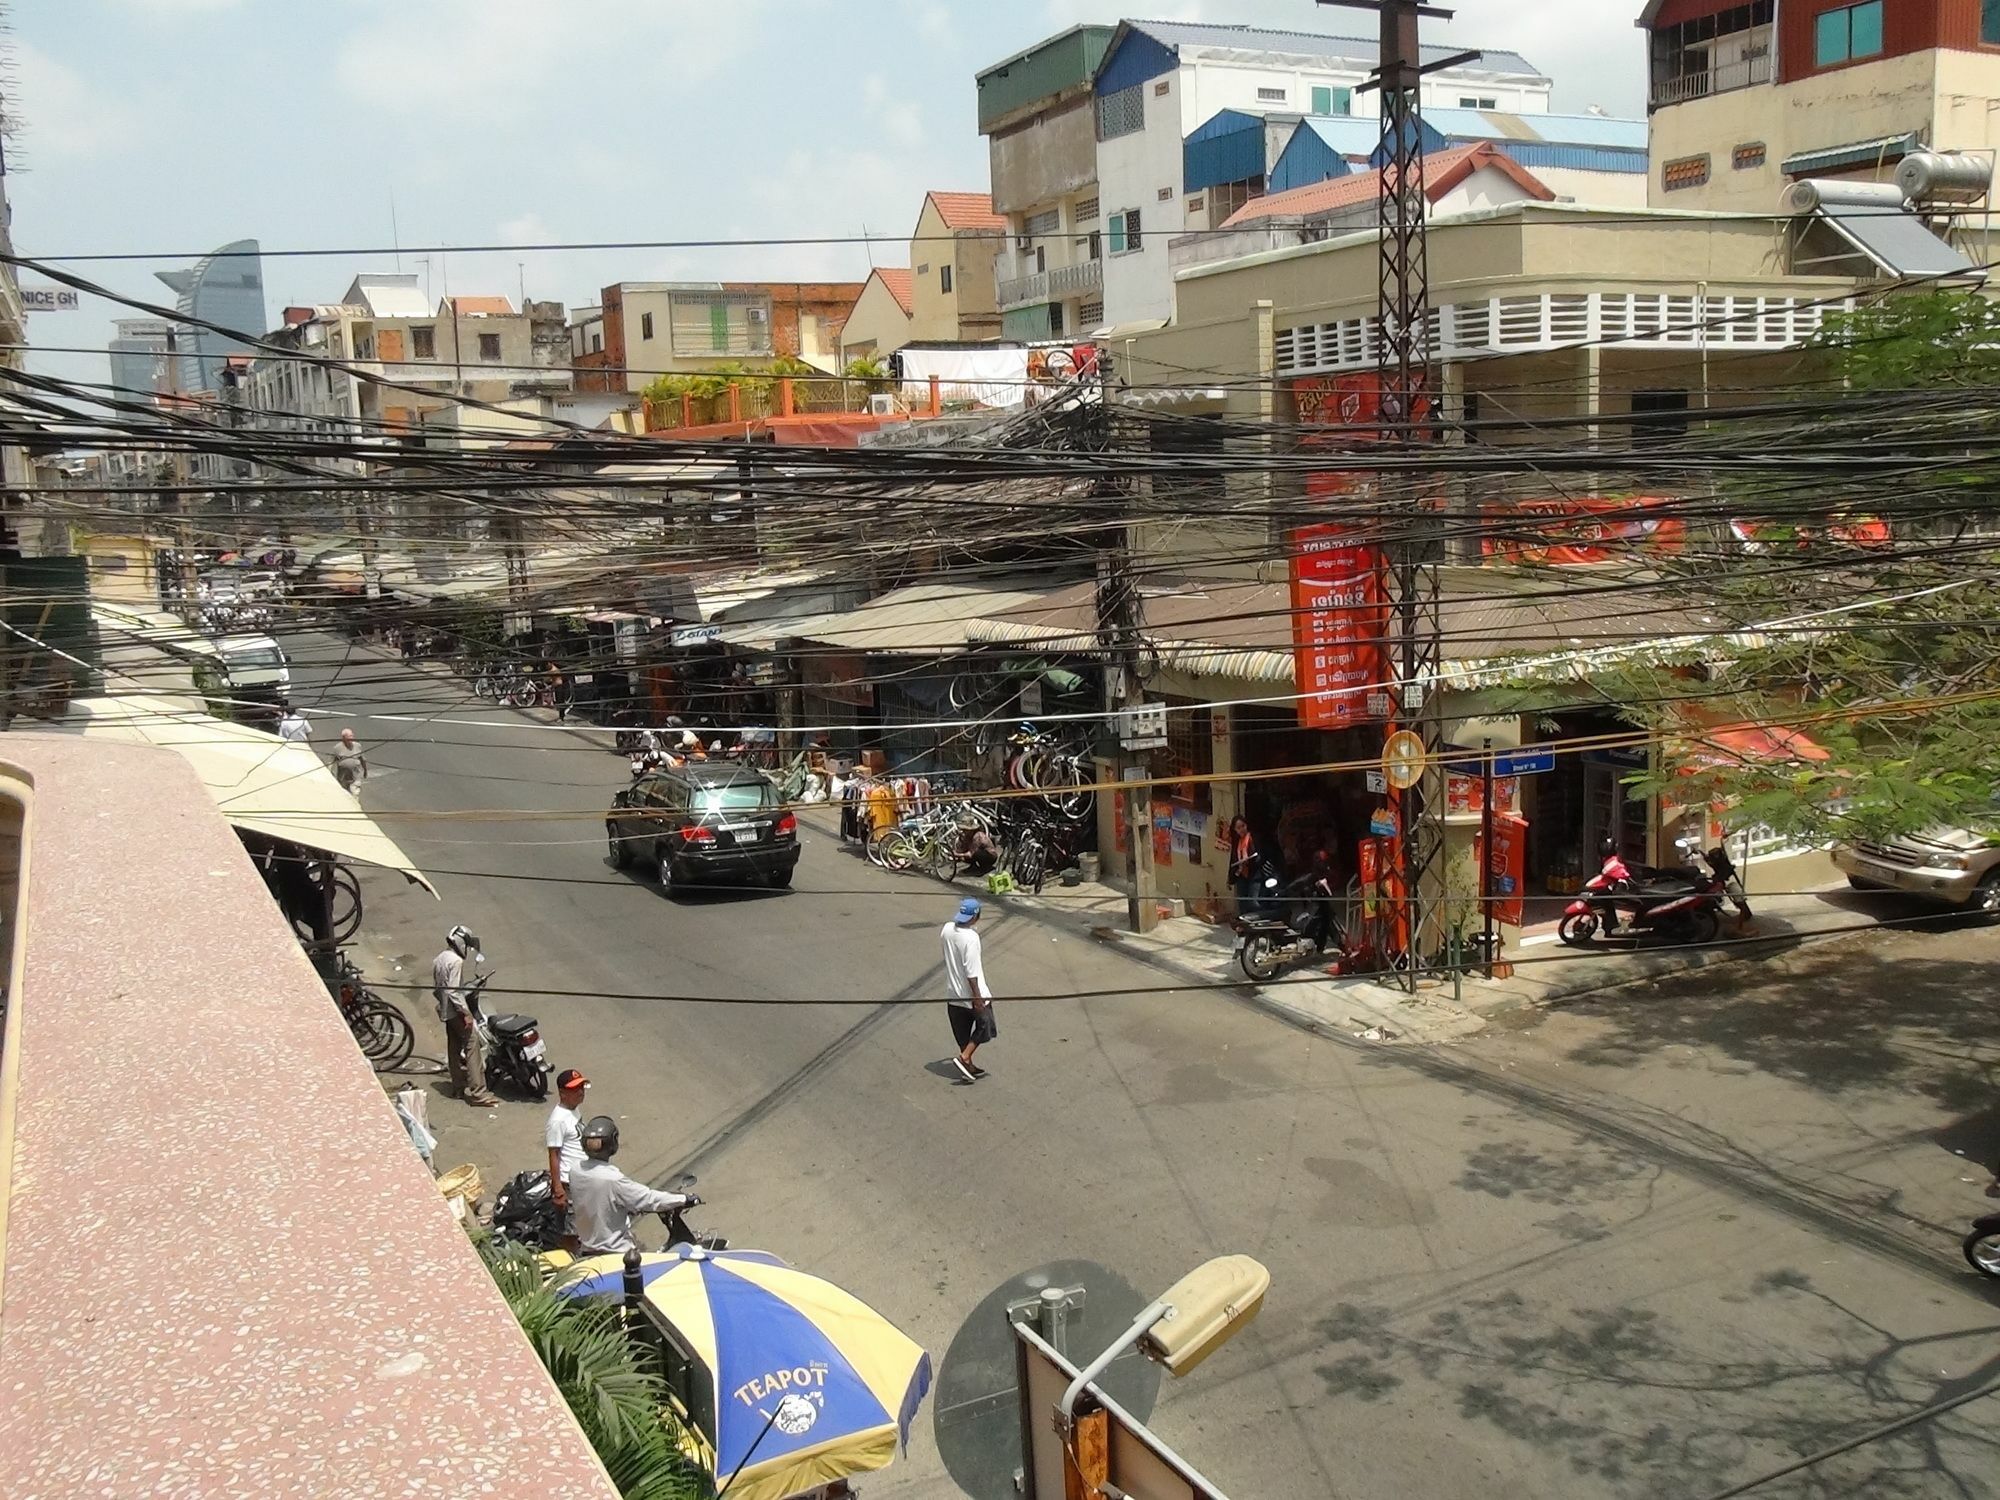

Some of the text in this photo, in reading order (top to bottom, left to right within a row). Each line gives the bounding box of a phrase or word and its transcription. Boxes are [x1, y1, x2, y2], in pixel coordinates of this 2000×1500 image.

[57, 291, 78, 305] GH
[1374, 778, 1382, 786] 2
[733, 1367, 829, 1407] TEAPOT
